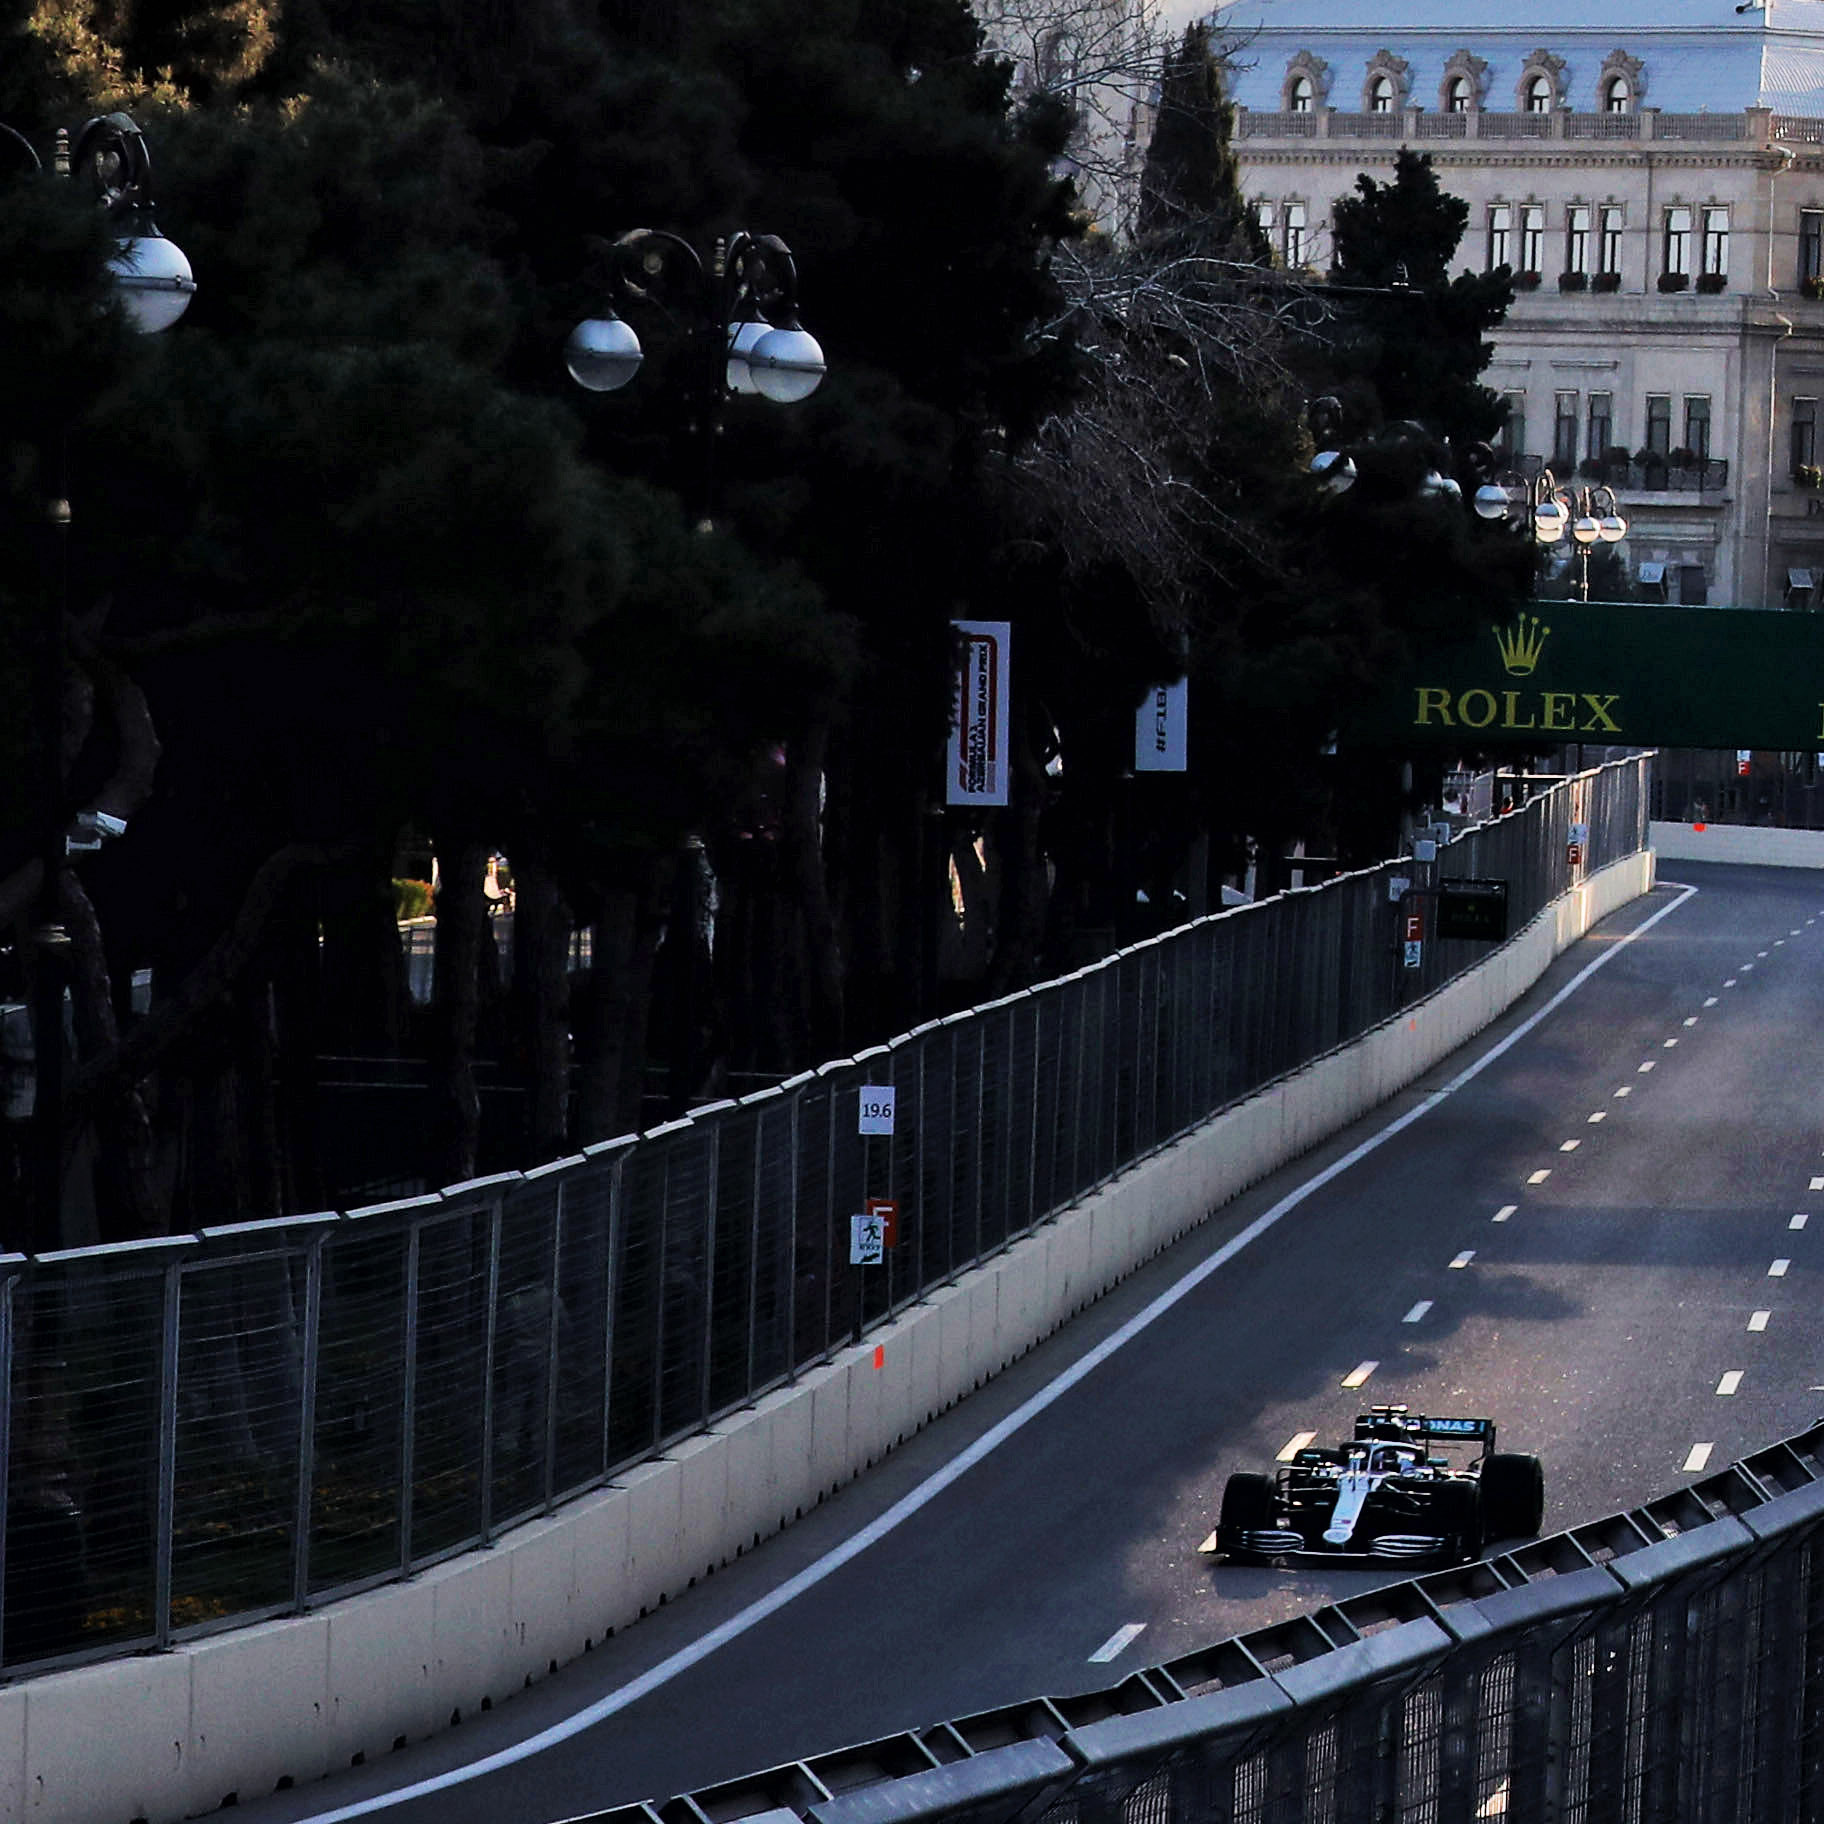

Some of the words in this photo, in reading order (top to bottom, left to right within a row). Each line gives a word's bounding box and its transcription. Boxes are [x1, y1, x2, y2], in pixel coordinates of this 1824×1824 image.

[979, 645, 988, 671] PRIX
[977, 675, 987, 716] GRAND
[1414, 687, 1622, 733] ROLEX
[968, 733, 977, 794] FORMULA
[1569, 847, 1577, 859] F
[1407, 916, 1419, 938] F
[863, 1103, 892, 1118] 19.6
